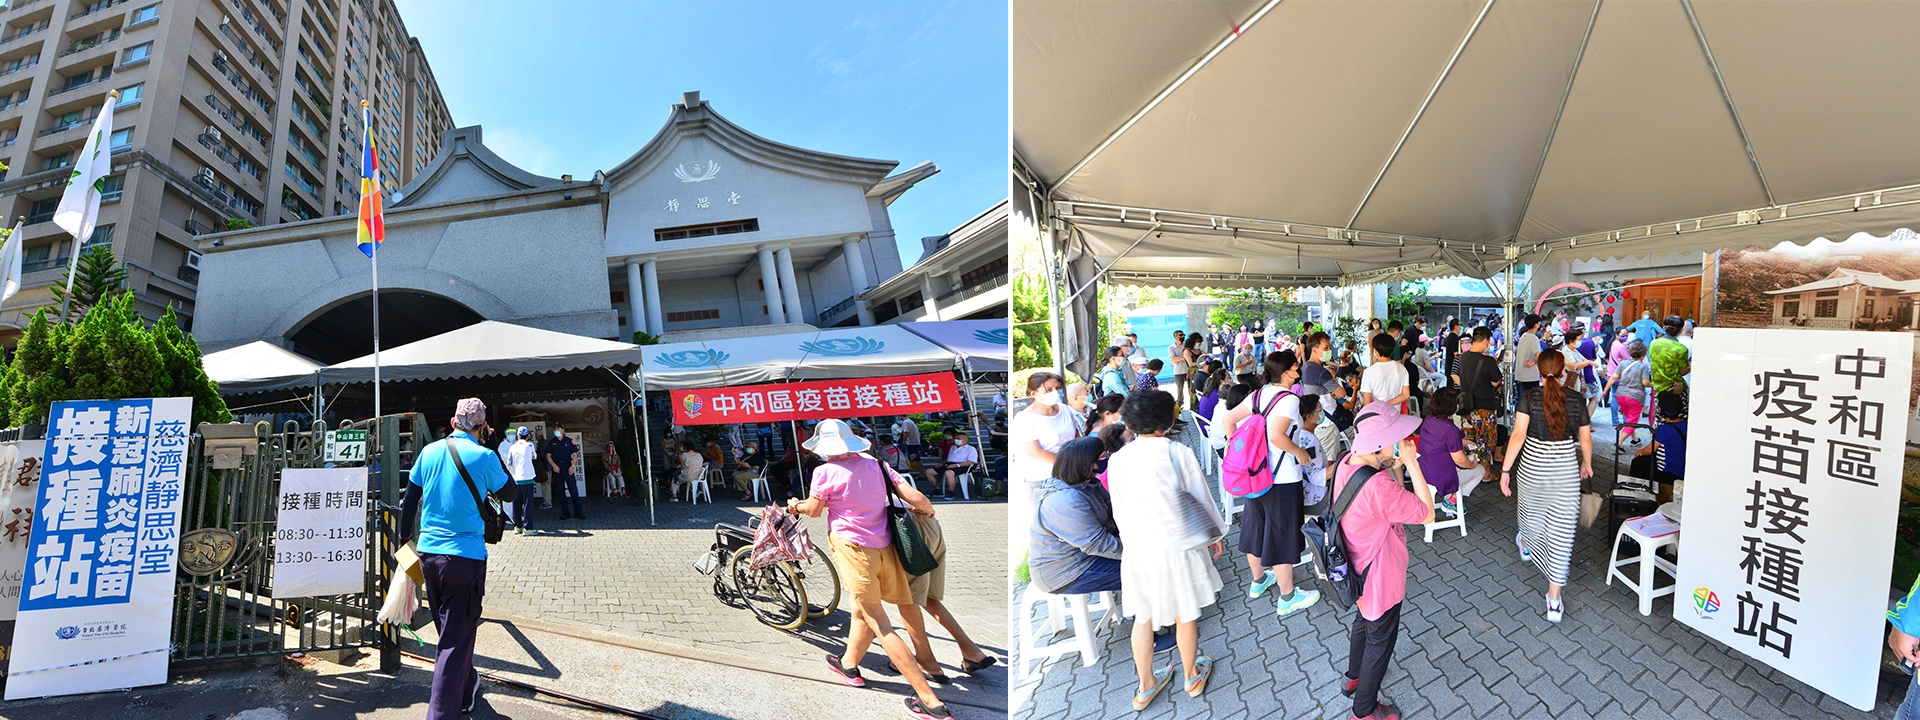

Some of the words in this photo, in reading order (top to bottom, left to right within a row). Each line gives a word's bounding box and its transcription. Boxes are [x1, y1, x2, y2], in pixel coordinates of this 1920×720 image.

[712, 380, 942, 417] 中和區疫苗接種站
[1827, 348, 1887, 487] 中和區
[29, 406, 111, 600] 接種站
[95, 405, 150, 599] 新冠肺炎疫苗
[138, 419, 186, 576] 慈濟靜思堂
[282, 490, 363, 511] 接種時間
[1733, 368, 1820, 659] 疫苗接種站
